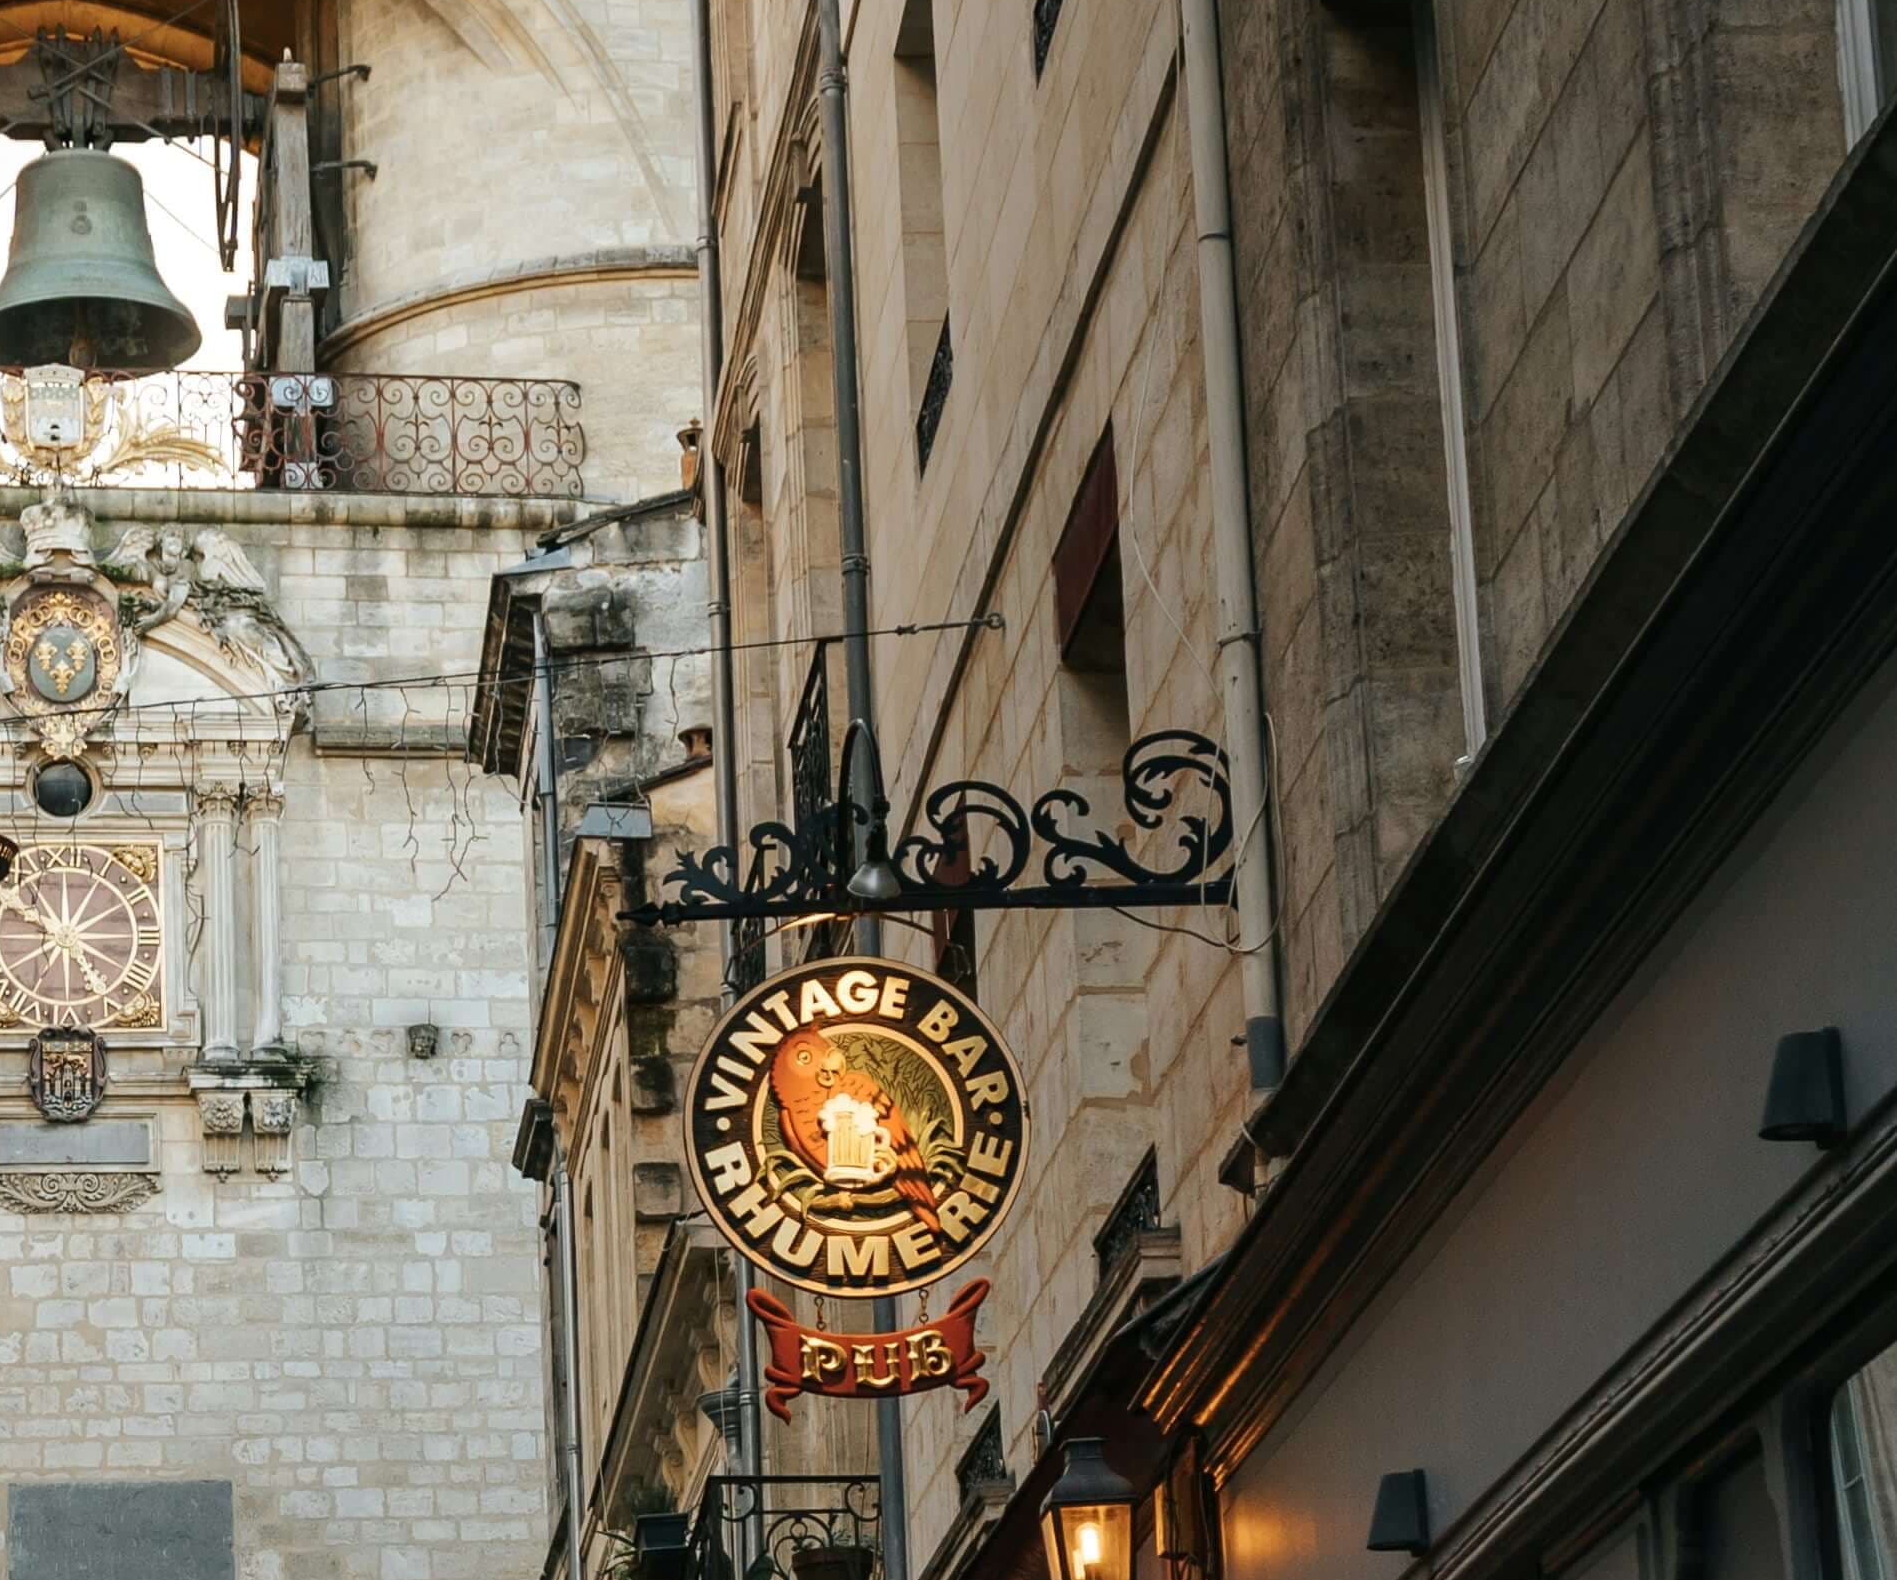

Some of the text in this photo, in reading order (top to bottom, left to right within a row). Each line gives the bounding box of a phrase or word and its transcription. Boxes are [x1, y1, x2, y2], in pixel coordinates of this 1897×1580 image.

[704, 970, 1009, 1113] VINTAGE BAR
[704, 1131, 1014, 1277] RHUMERIE
[800, 1330, 956, 1389] PUB
